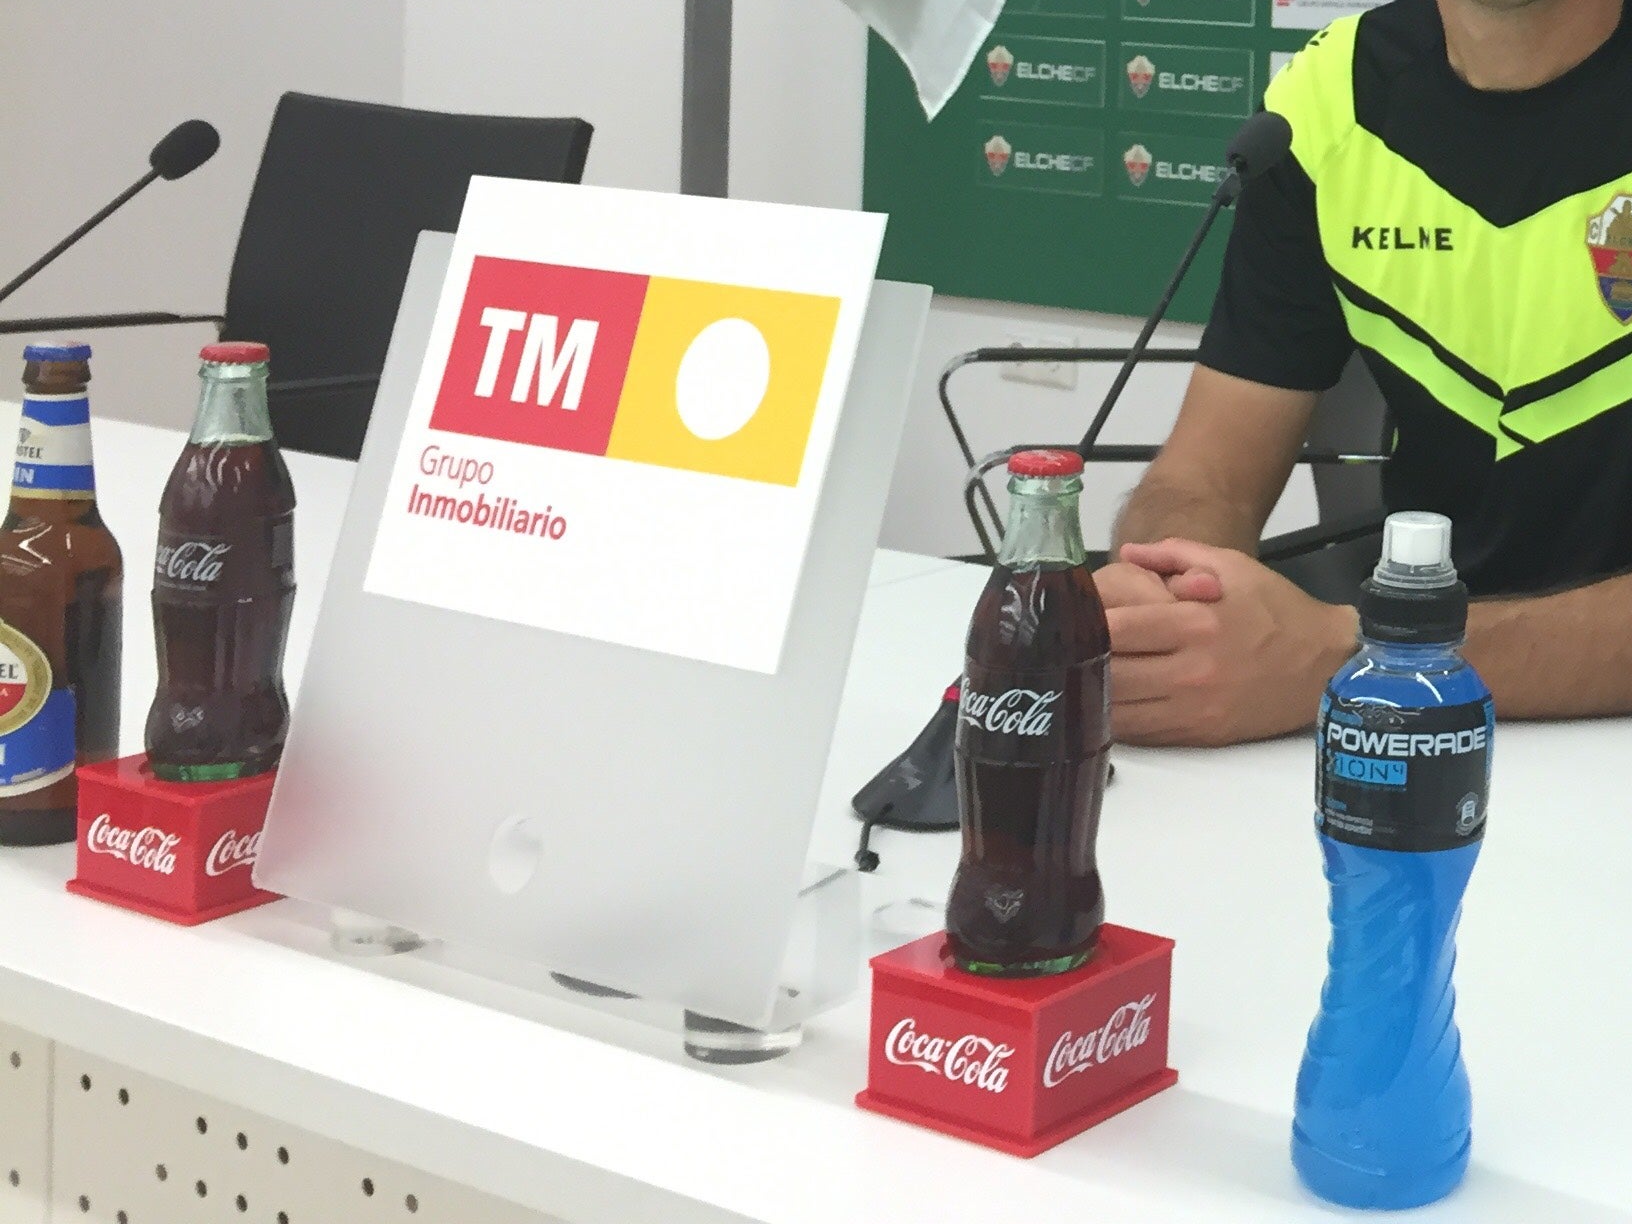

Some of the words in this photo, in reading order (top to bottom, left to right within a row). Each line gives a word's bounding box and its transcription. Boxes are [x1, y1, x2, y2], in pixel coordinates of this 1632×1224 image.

[1016, 61, 1097, 83] ELCHECF
[1158, 72, 1245, 94] ELCHECF
[1014, 151, 1095, 172] ELCHECF
[1351, 225, 1455, 252] KELME
[474, 306, 600, 412] TM
[419, 444, 495, 487] Grupo
[407, 484, 568, 542] Inmobiliario
[1326, 722, 1487, 757] POWERADE
[87, 812, 182, 875] Coca-Cola
[884, 1017, 1017, 1096] Coca-Cola
[1043, 992, 1157, 1089] Coca-Cola
